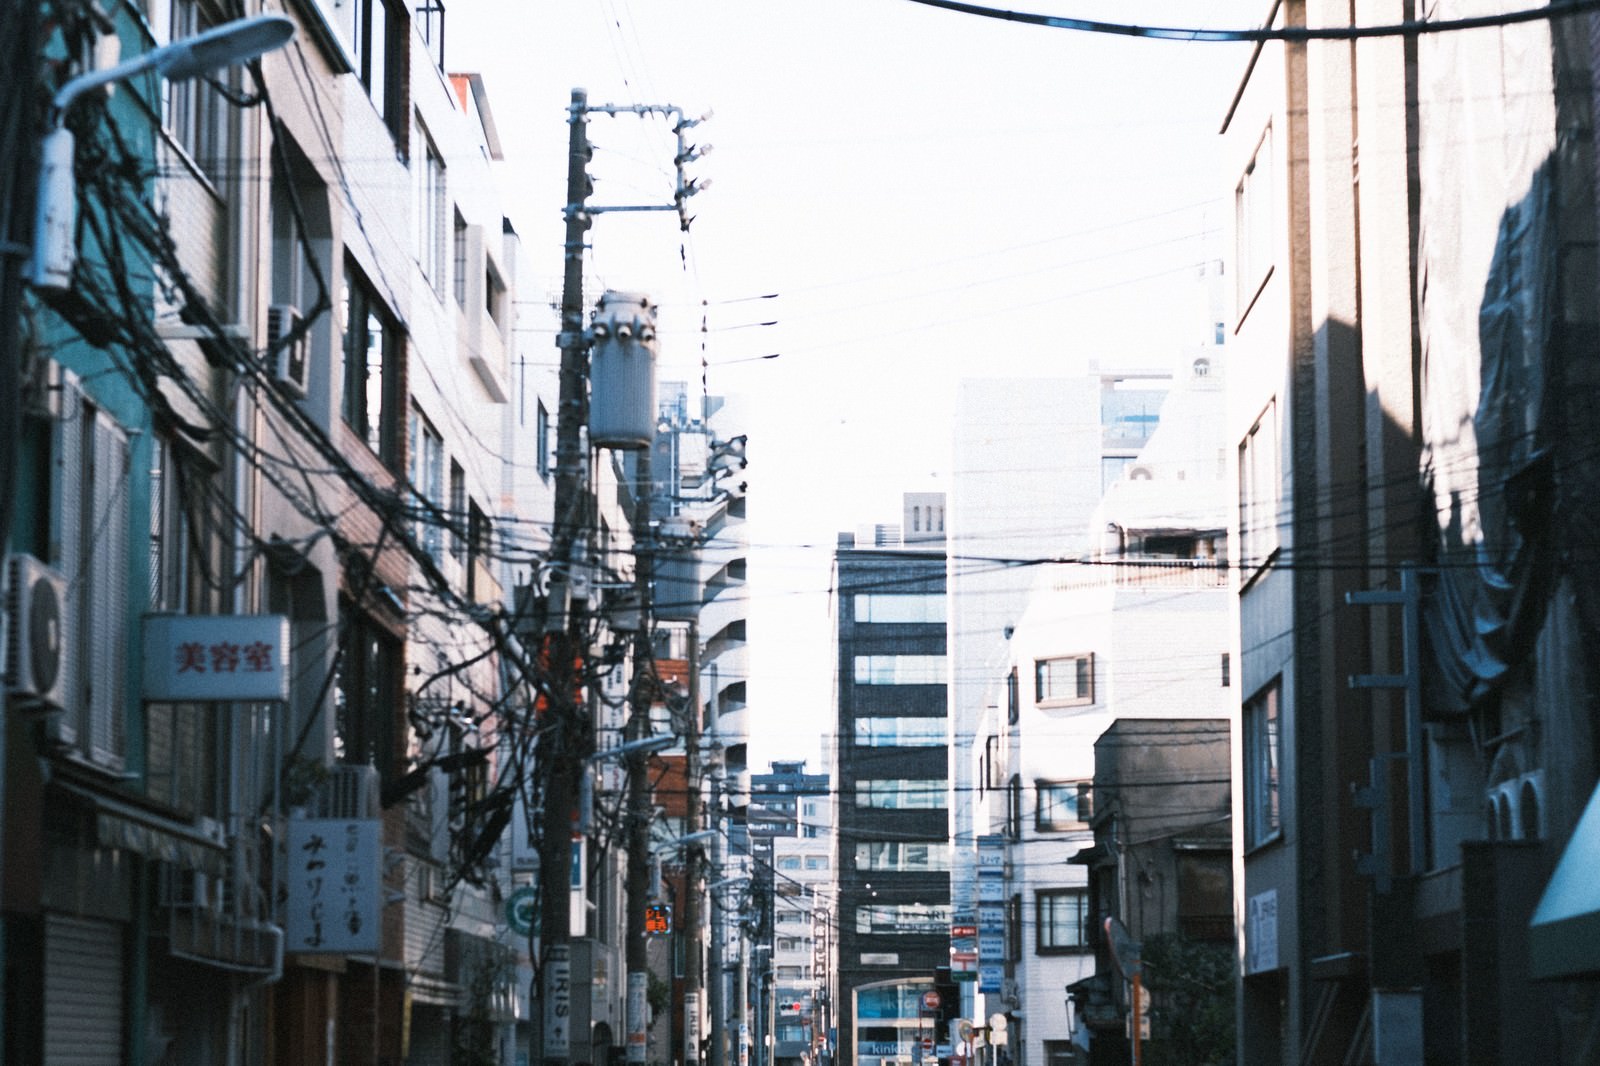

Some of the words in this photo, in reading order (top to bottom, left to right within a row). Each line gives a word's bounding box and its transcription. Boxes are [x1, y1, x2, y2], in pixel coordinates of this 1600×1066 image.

[176, 641, 274, 673] 美容室
[555, 969, 569, 1018] IRIS
[690, 1009, 698, 1037] IRIS
